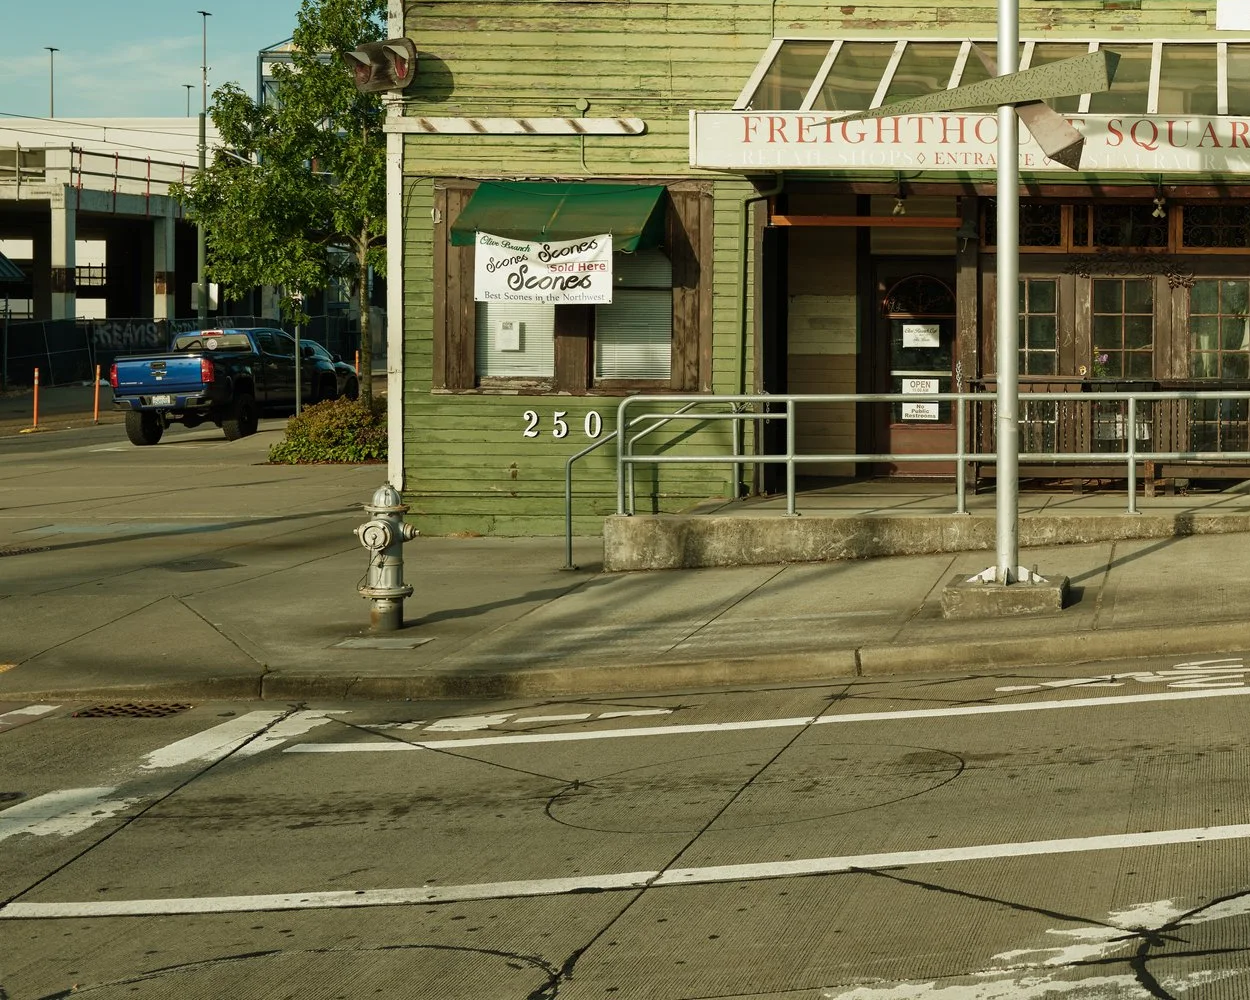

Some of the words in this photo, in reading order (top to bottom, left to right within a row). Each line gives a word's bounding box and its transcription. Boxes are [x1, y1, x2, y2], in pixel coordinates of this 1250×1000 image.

[741, 116, 1086, 146] FREIGHTHO
[935, 152, 1035, 166] ENTRAE
[480, 235, 499, 247] Olive
[501, 240, 531, 252] Branch
[538, 239, 598, 262] Scones
[486, 254, 528, 273] Scones
[550, 263, 574, 272] Sold
[578, 263, 606, 271] Here
[507, 264, 592, 291] Scones
[484, 290, 501, 299] Best
[504, 292, 532, 301] Scones
[535, 293, 544, 301] in
[547, 293, 560, 301] the
[563, 292, 604, 301] Northwest
[910, 380, 931, 389] OPEN
